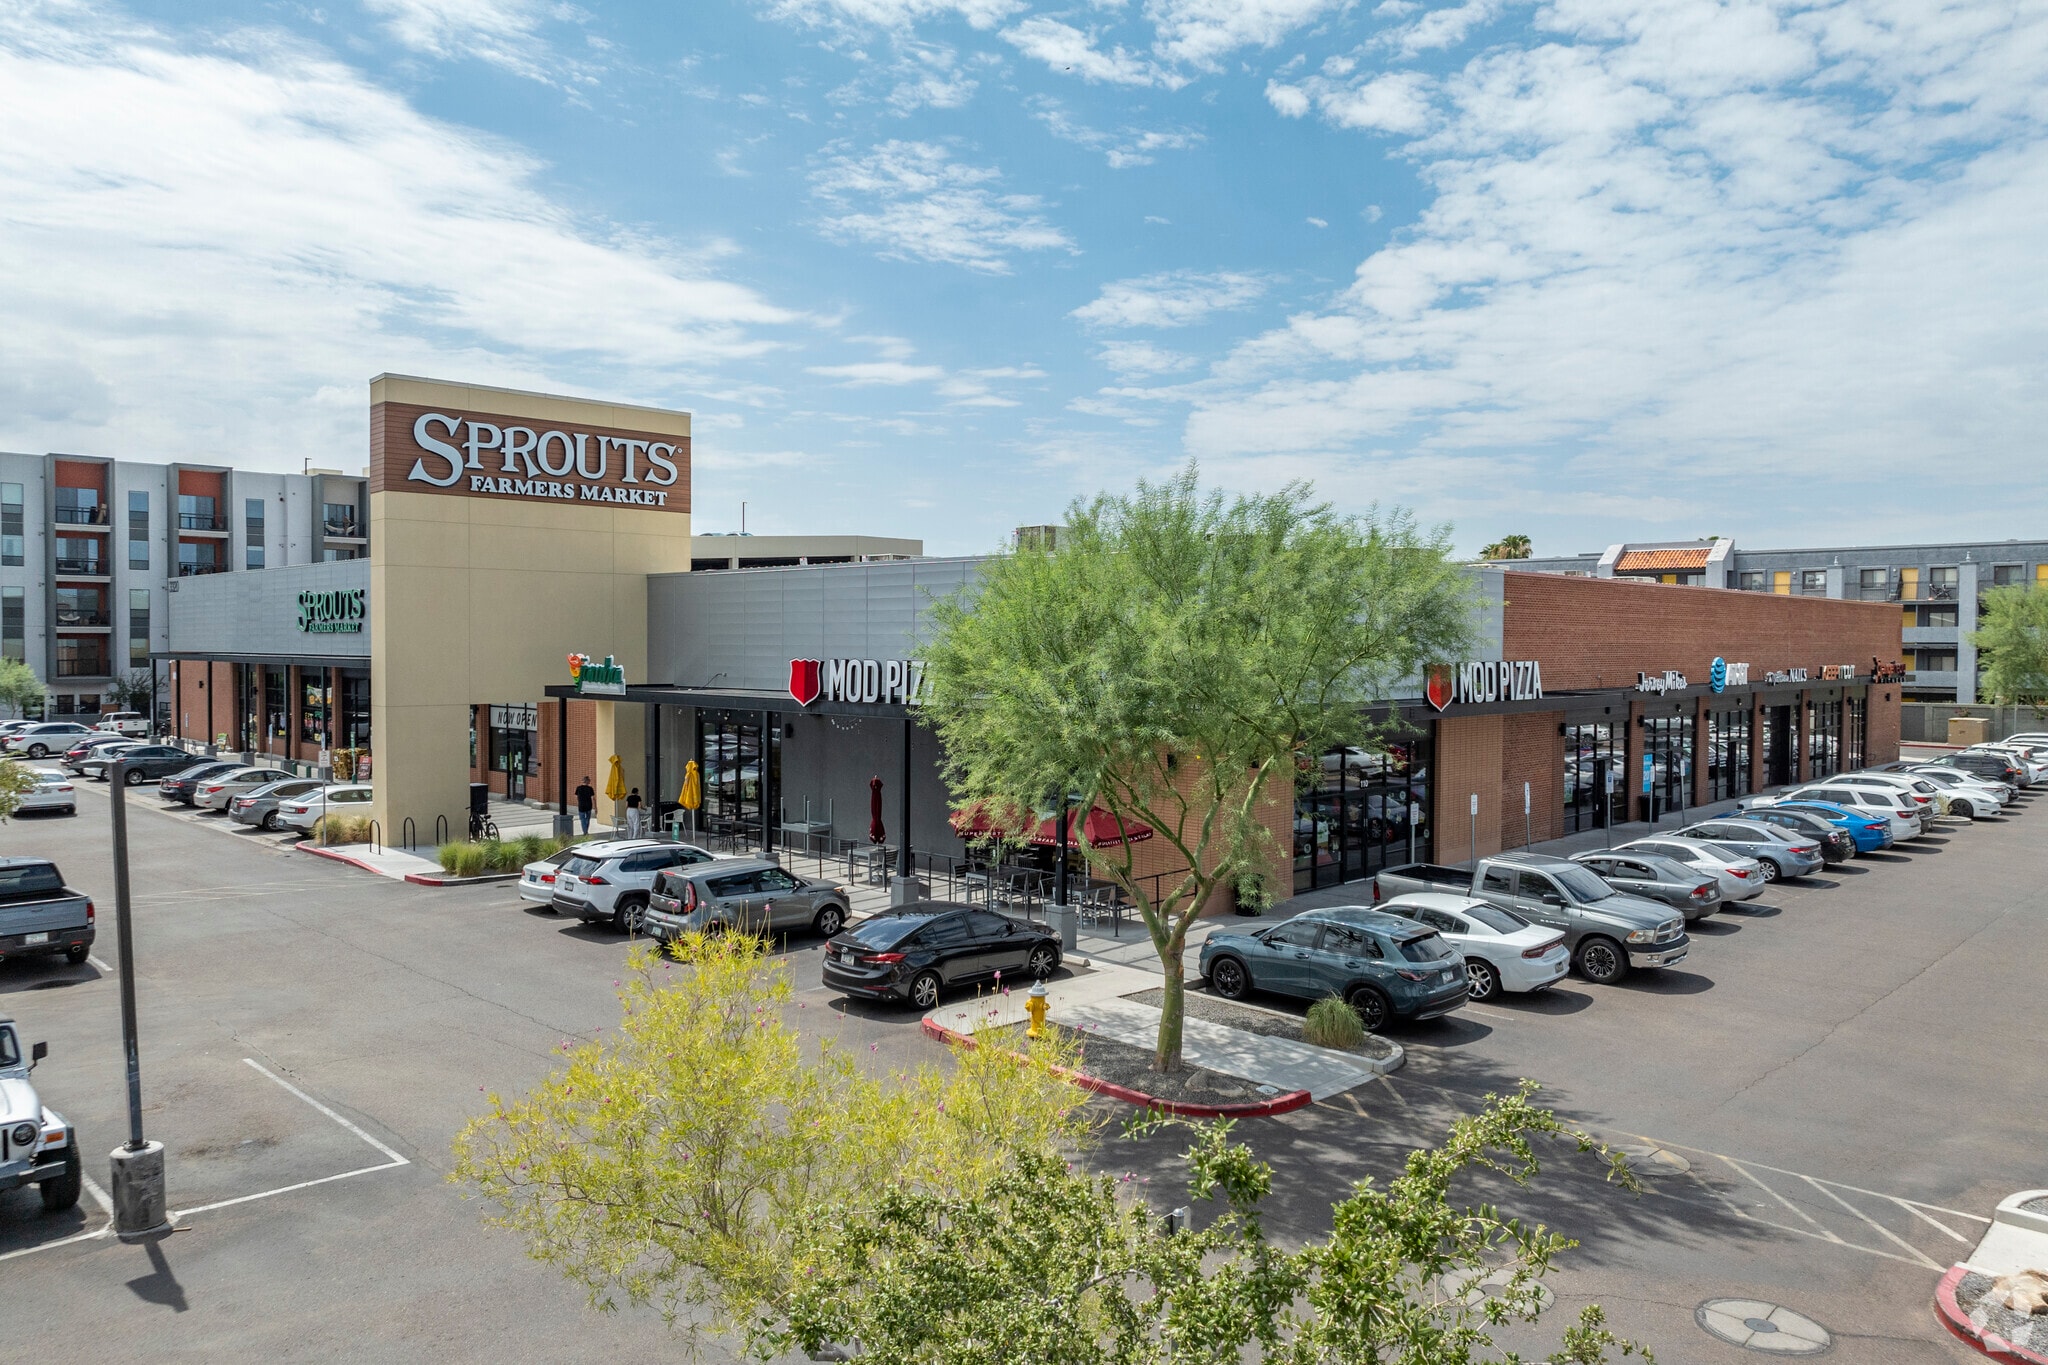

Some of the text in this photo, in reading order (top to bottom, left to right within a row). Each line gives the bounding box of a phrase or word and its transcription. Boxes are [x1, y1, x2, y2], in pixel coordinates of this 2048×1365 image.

[407, 413, 679, 488] SPROUTS
[469, 475, 668, 507] FARMERS MARKET
[296, 588, 362, 632] SPROUTS
[309, 621, 359, 633] FARMERS MARKET
[828, 659, 880, 704] MOD
[1460, 660, 1543, 704] MOD PIZZA
[497, 711, 515, 725] NOW
